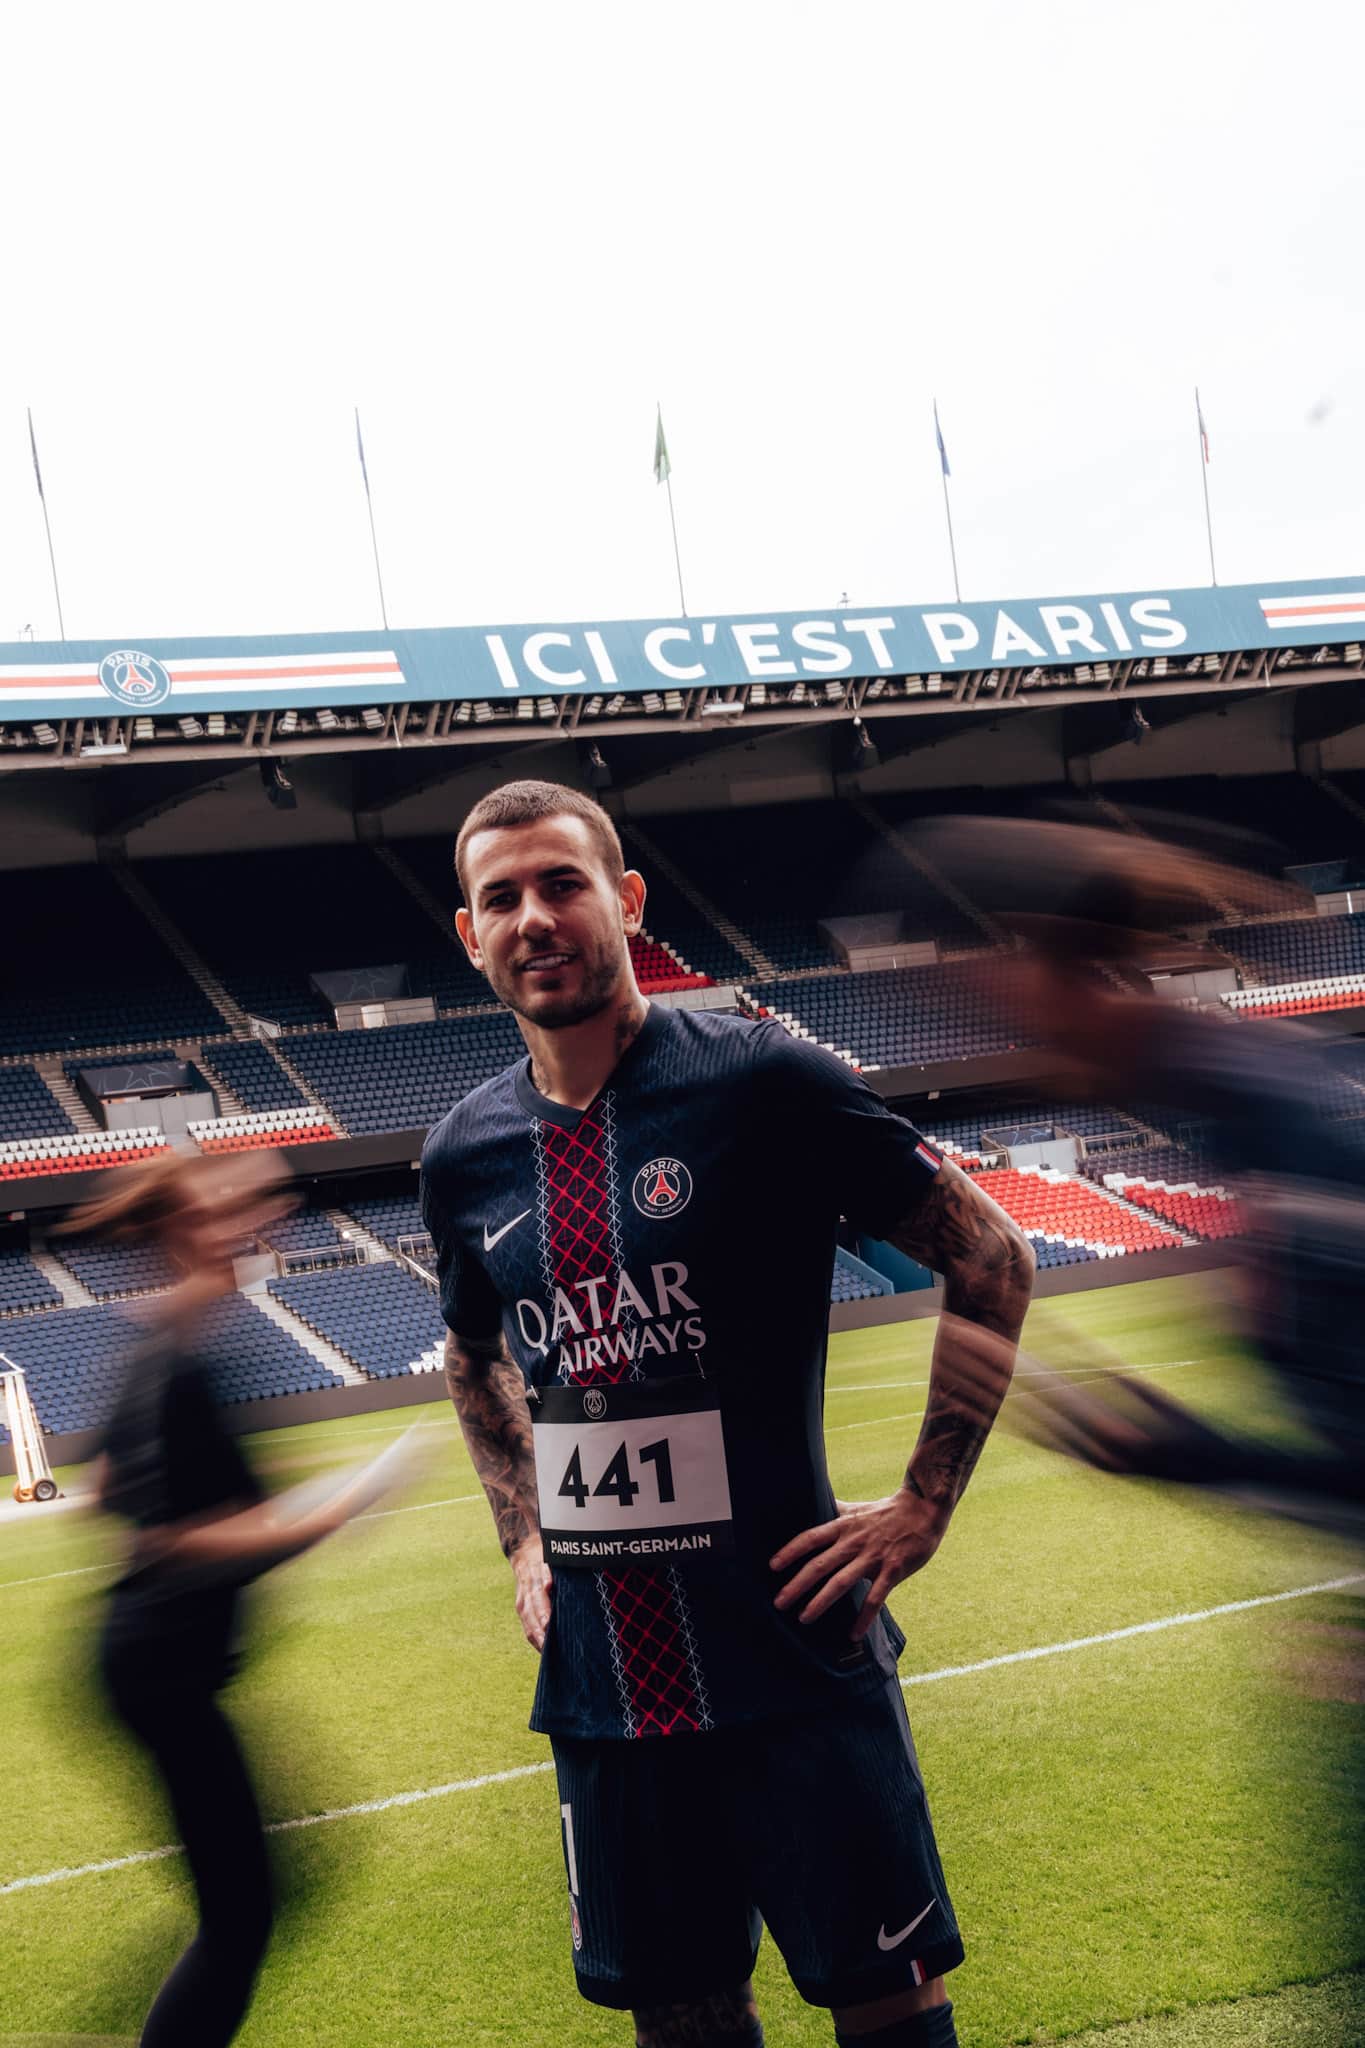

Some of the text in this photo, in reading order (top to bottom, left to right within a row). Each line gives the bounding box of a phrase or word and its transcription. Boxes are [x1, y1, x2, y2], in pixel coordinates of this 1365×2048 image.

[485, 598, 1188, 688] ICI C'EST PARIS
[641, 1160, 681, 1179] PARIS
[515, 1261, 701, 1357] QATAR
[556, 1316, 707, 1376] AIRWAYS
[557, 1437, 676, 1508] 441
[550, 1534, 712, 1556] PARIS SAINT-GERMAIN
